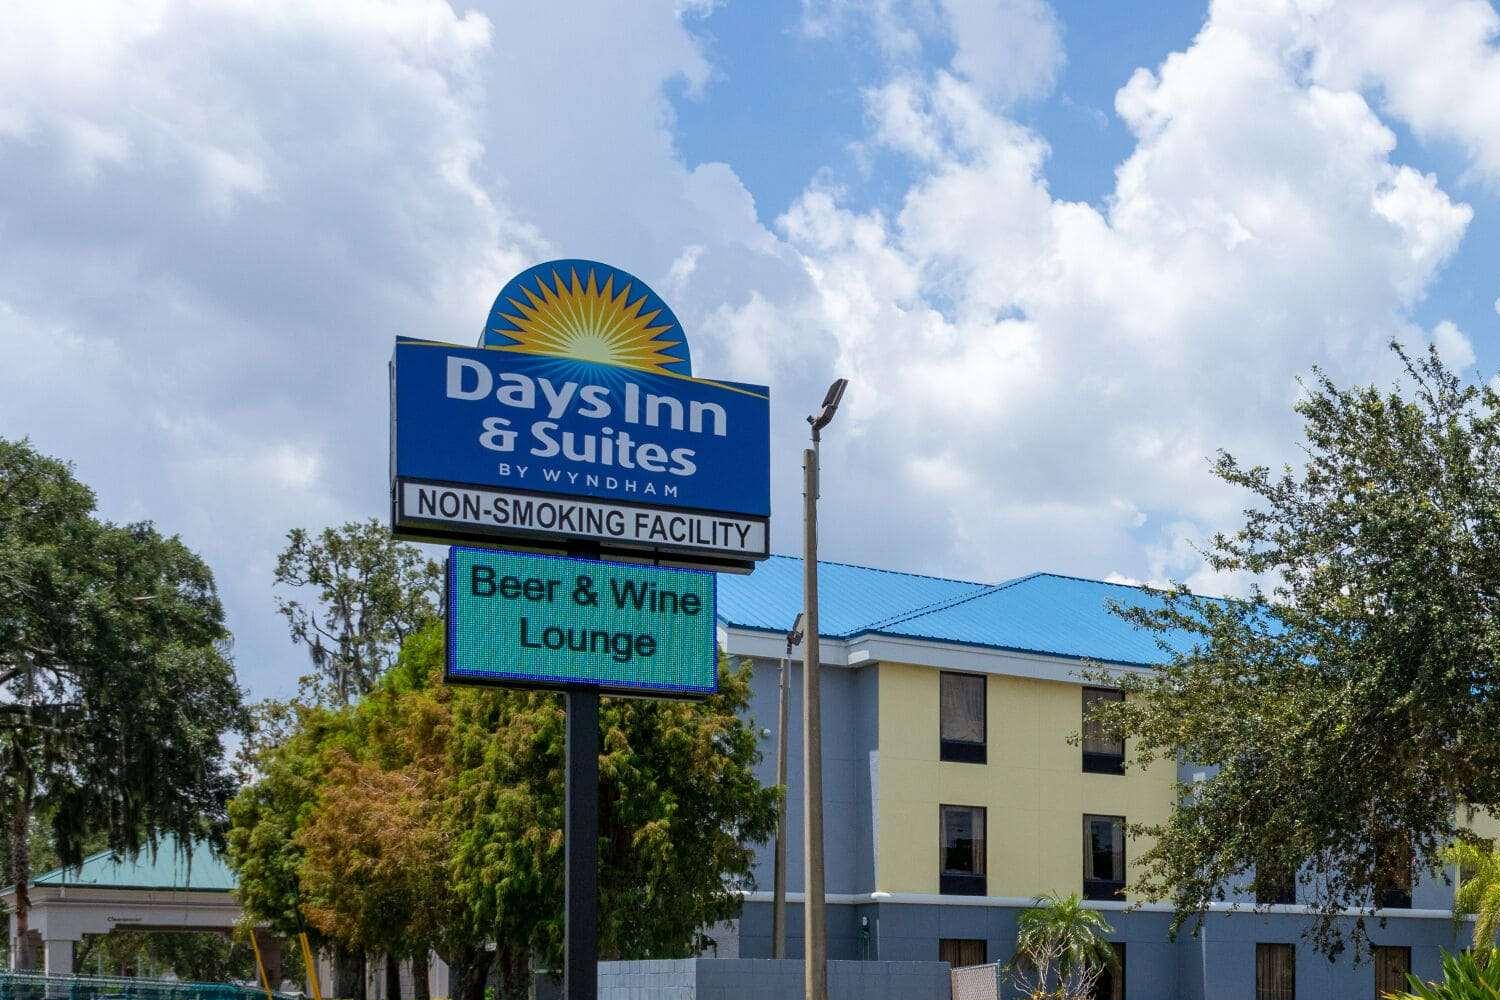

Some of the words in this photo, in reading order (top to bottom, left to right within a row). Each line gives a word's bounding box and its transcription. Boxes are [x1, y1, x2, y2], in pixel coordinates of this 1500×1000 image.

[445, 355, 613, 419] Days
[624, 382, 728, 437] Inn
[478, 416, 519, 452] &
[530, 421, 698, 476] Suites
[499, 463, 529, 479] BY
[543, 468, 679, 498] WYNDHAM
[418, 488, 625, 536] NON-SMOKING
[635, 512, 752, 548] FACILITY
[471, 564, 561, 602] Beer
[572, 575, 599, 606] &
[610, 578, 702, 615] Wine
[519, 616, 657, 663] Lounge
